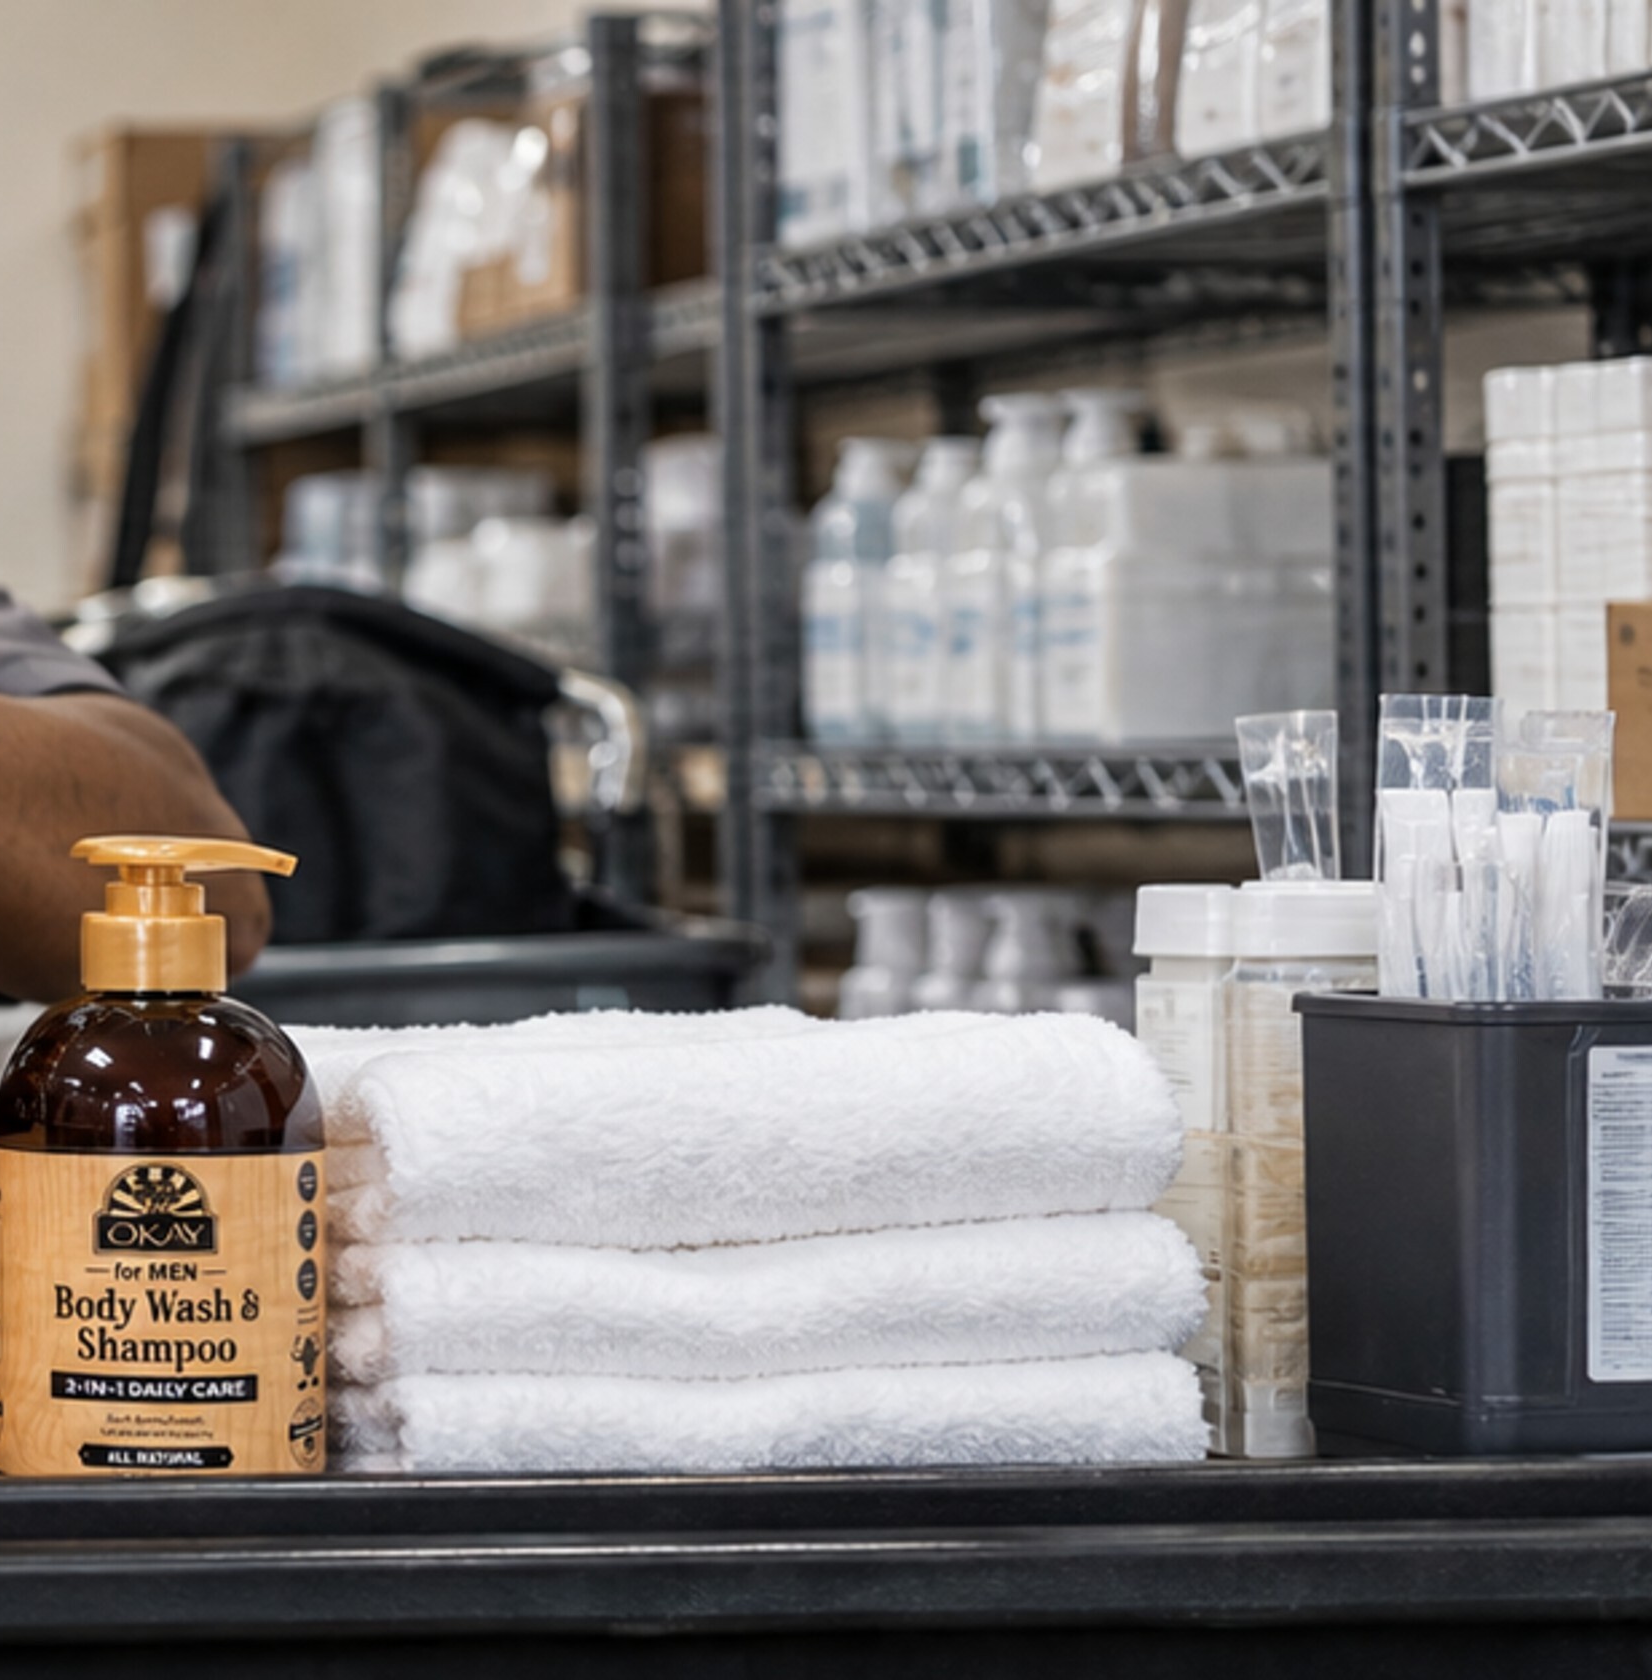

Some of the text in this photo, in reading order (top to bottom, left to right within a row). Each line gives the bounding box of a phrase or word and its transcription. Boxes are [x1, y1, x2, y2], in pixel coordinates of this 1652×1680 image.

[107, 1221, 205, 1246] OKAY
[114, 1262, 198, 1281] for MEN
[54, 1284, 259, 1330] Body Wash &
[77, 1326, 237, 1373] Shampoo
[128, 1381, 188, 1398] DAILY
[192, 1381, 246, 1398] CARE
